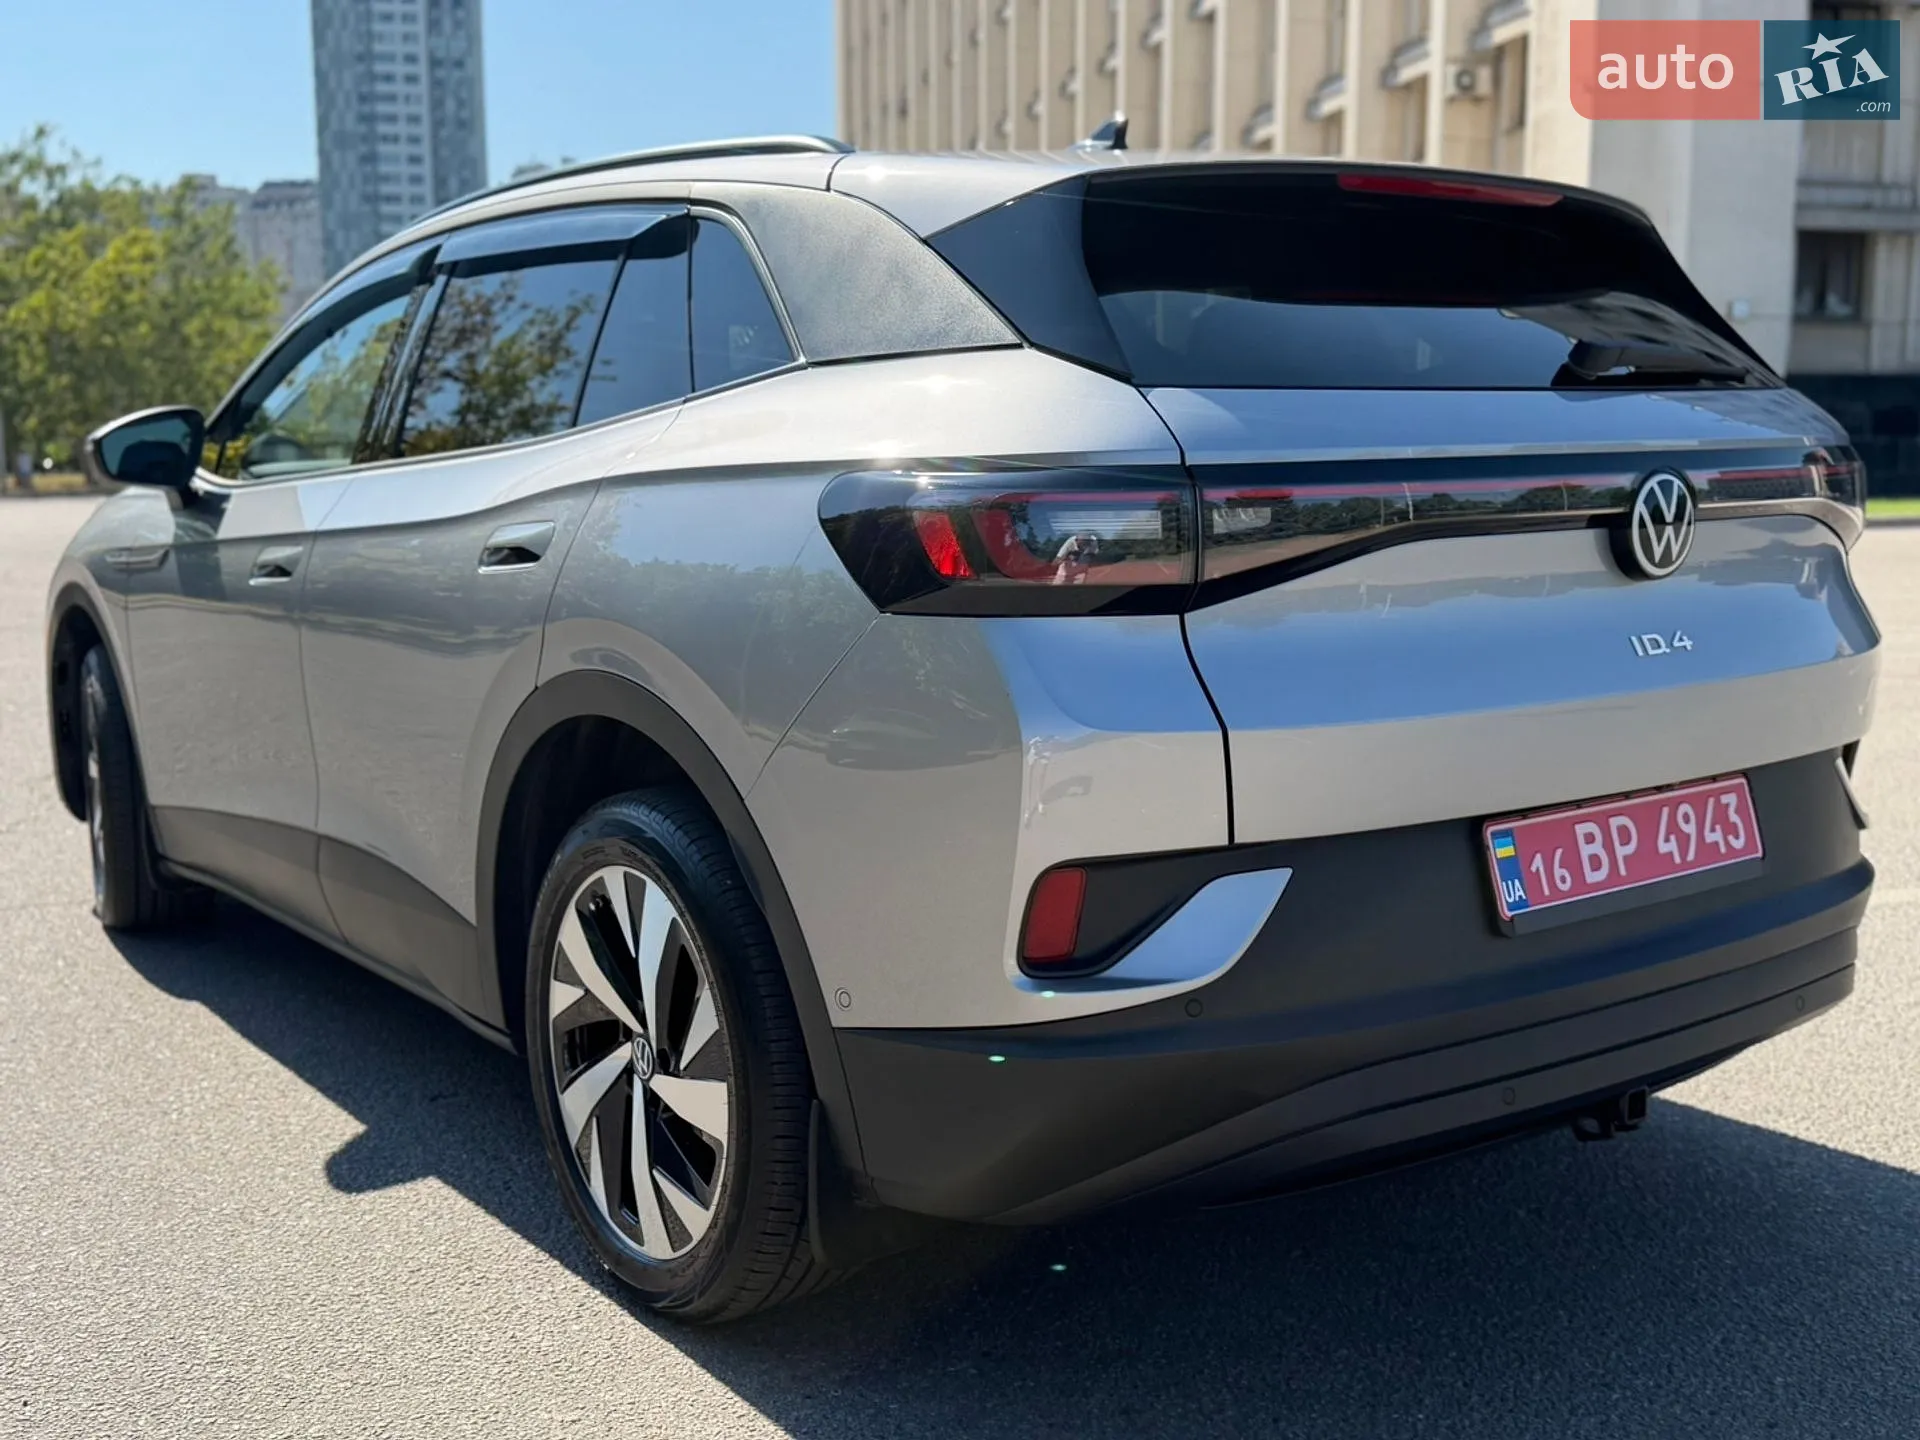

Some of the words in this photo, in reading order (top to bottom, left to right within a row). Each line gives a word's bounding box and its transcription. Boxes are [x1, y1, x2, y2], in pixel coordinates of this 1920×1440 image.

[1530, 847, 1572, 896] 16
[1574, 815, 1638, 885] BP
[1657, 792, 1746, 866] 4943
[1502, 878, 1527, 903] UA
